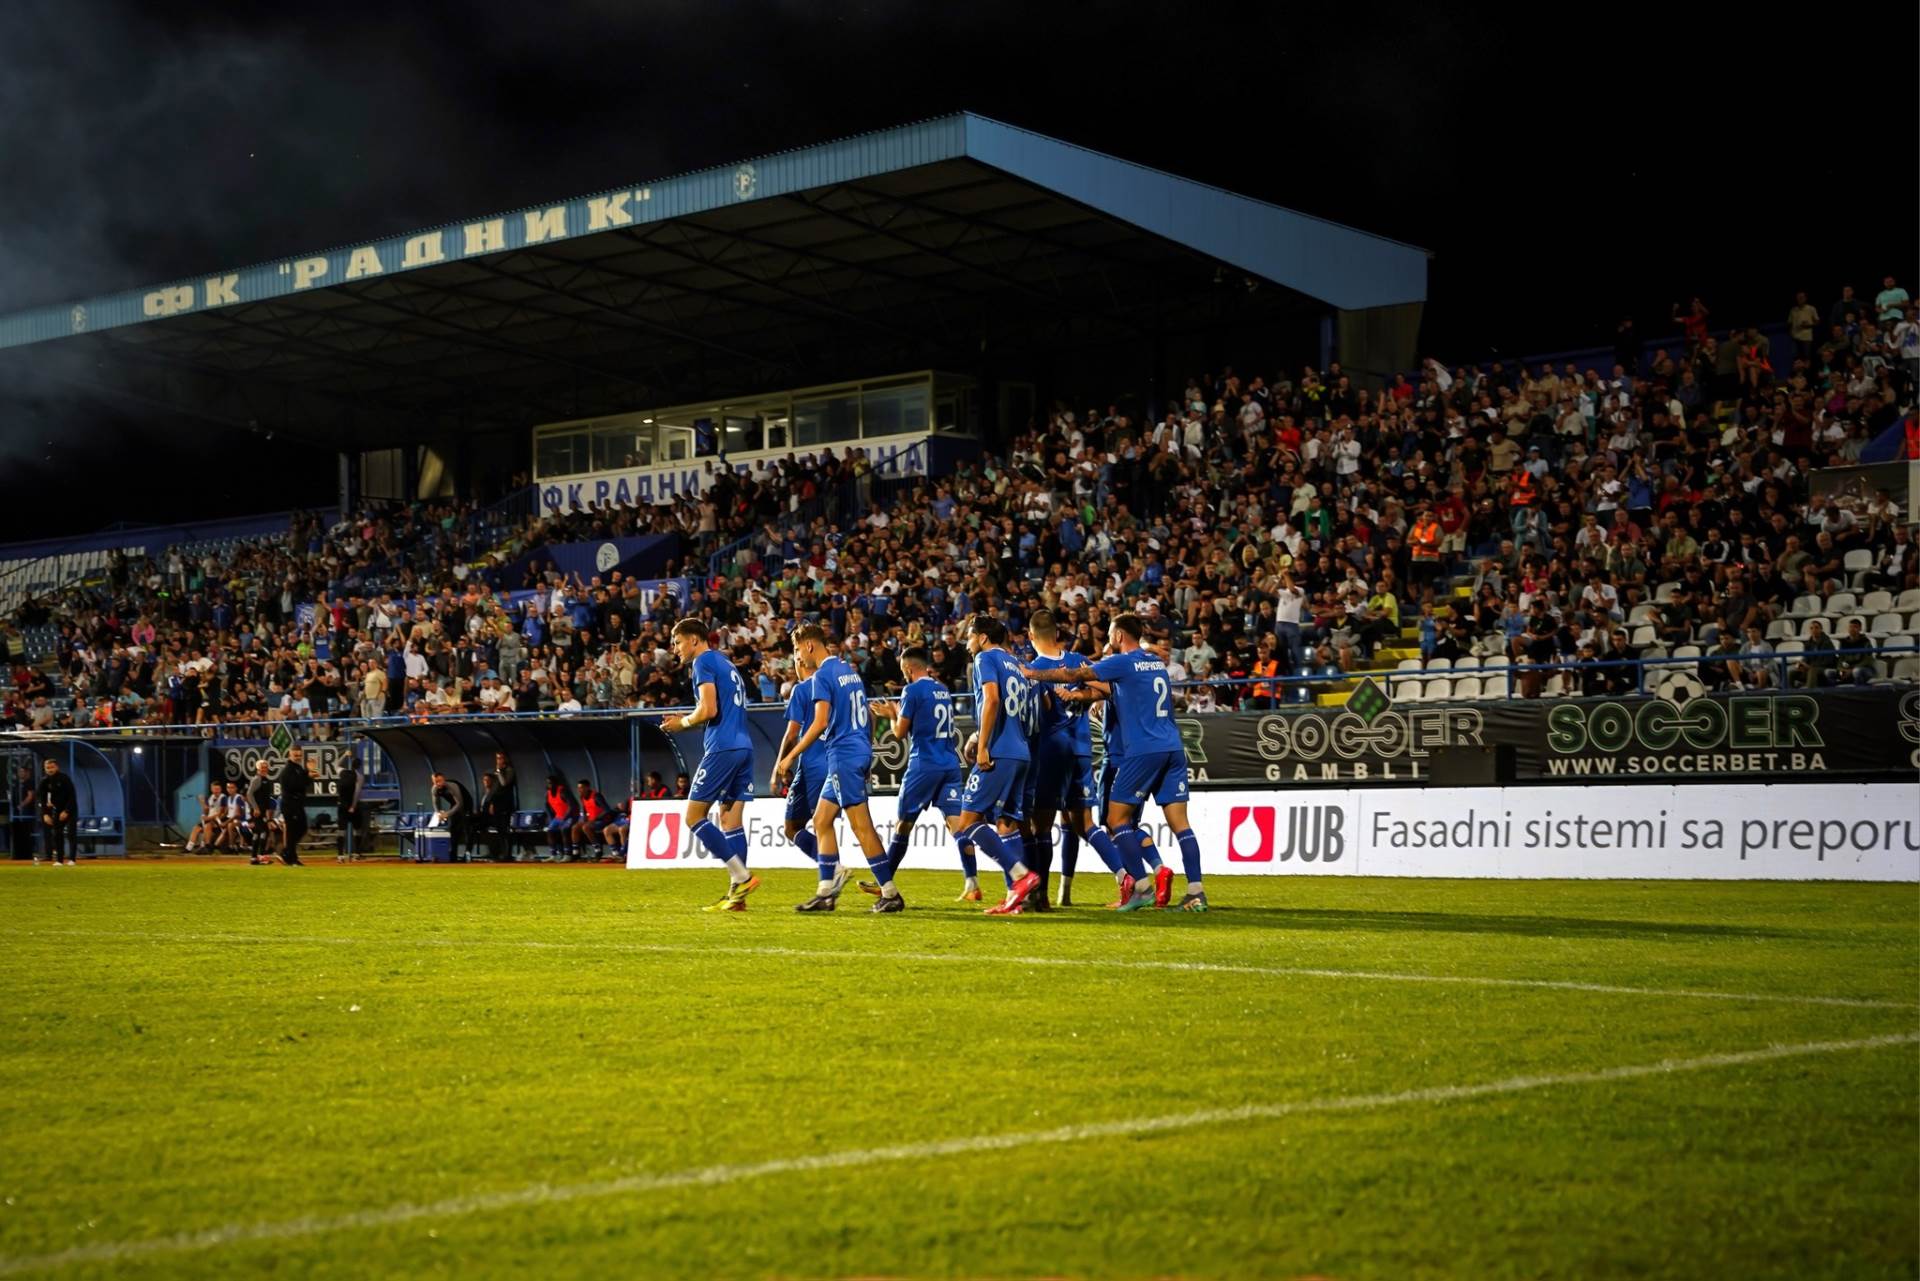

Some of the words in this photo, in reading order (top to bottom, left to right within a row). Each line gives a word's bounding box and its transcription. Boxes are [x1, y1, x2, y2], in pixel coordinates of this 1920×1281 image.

[143, 274, 240, 316] ФК
[279, 188, 650, 289] "РАДНИК"
[543, 483, 584, 510] ФК
[595, 468, 705, 507] РАДНИ
[849, 689, 868, 730] 16
[1153, 676, 1168, 717] 2
[1547, 695, 1825, 753] SOCCER
[1266, 761, 1421, 780] GAMBLI
[1548, 752, 1827, 775] WWW.SOCCERBET.BA
[1280, 805, 1344, 862] JUB
[1372, 809, 1511, 848] Fasadni
[1524, 810, 1667, 849] sistemi
[1680, 819, 1723, 849] sa
